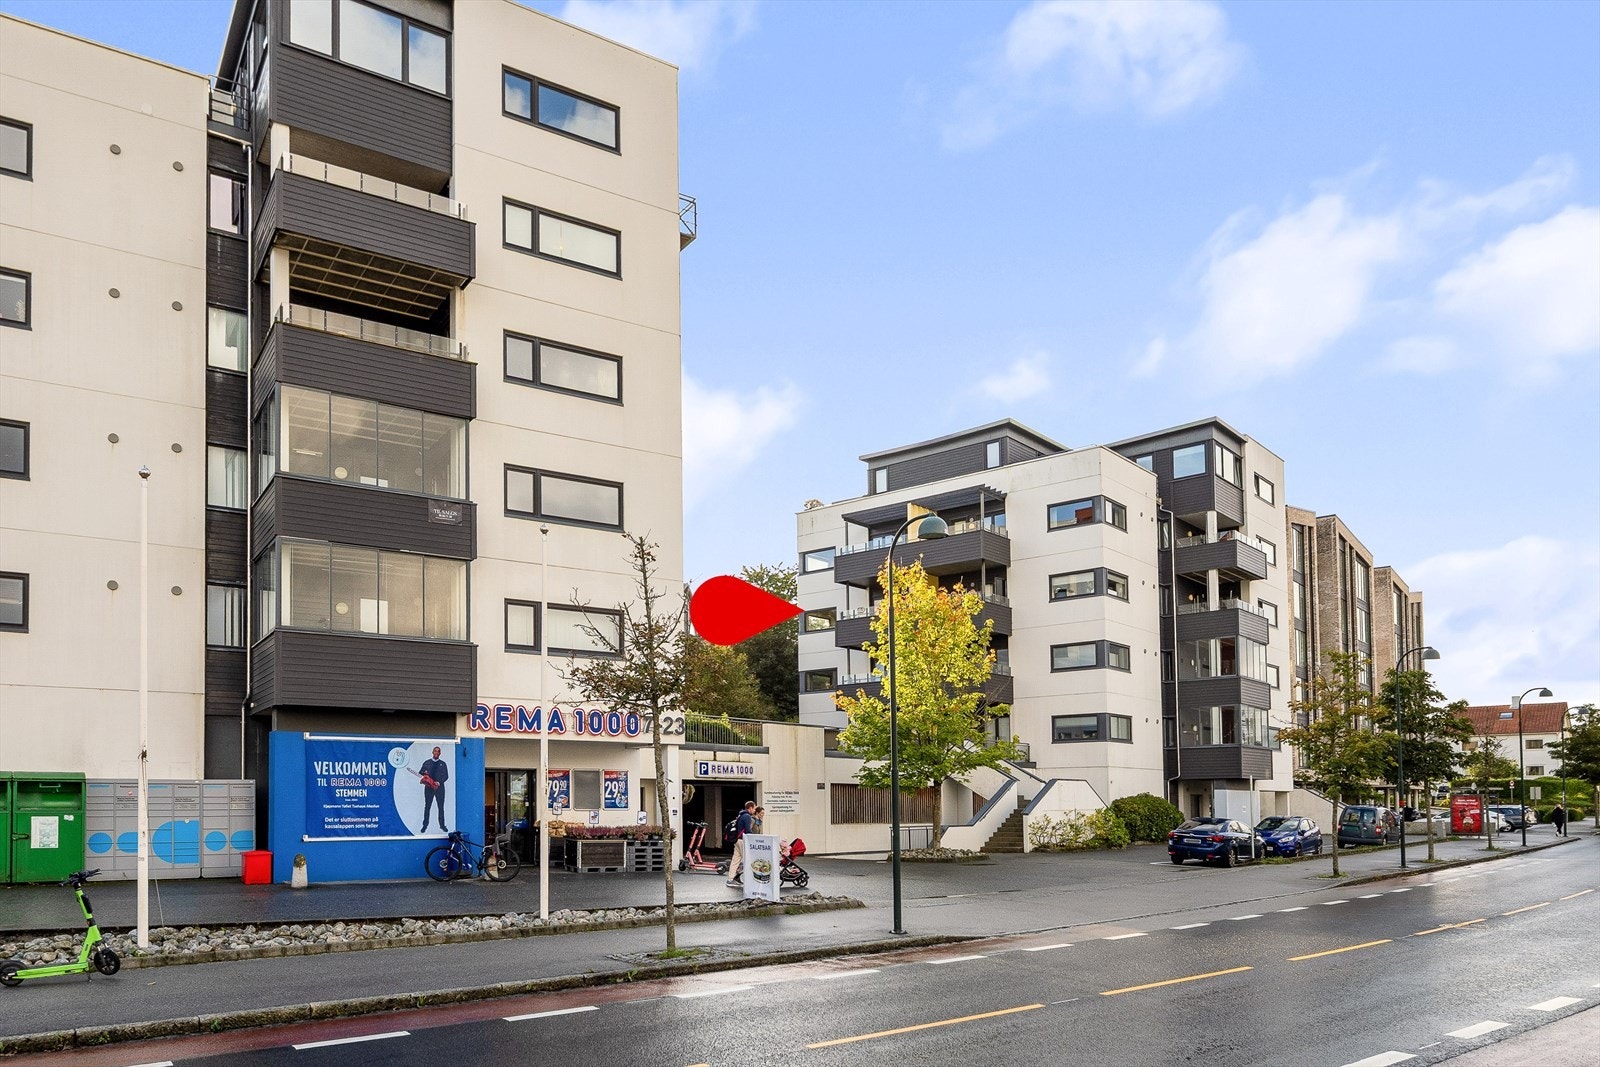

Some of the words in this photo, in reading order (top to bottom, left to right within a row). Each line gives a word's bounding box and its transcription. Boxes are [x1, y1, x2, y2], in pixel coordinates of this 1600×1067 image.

[467, 703, 566, 734] REMA
[573, 708, 641, 737] 1000
[314, 761, 387, 775] VELKOMMEN
[711, 765, 735, 774] REMA
[736, 765, 754, 775] 1000
[317, 778, 328, 786] TIL
[330, 778, 362, 786] REMA
[364, 778, 387, 786] 1000
[335, 789, 367, 797] STEMMEN
[605, 781, 618, 798] 29
[749, 843, 771, 851] SALATBAR
